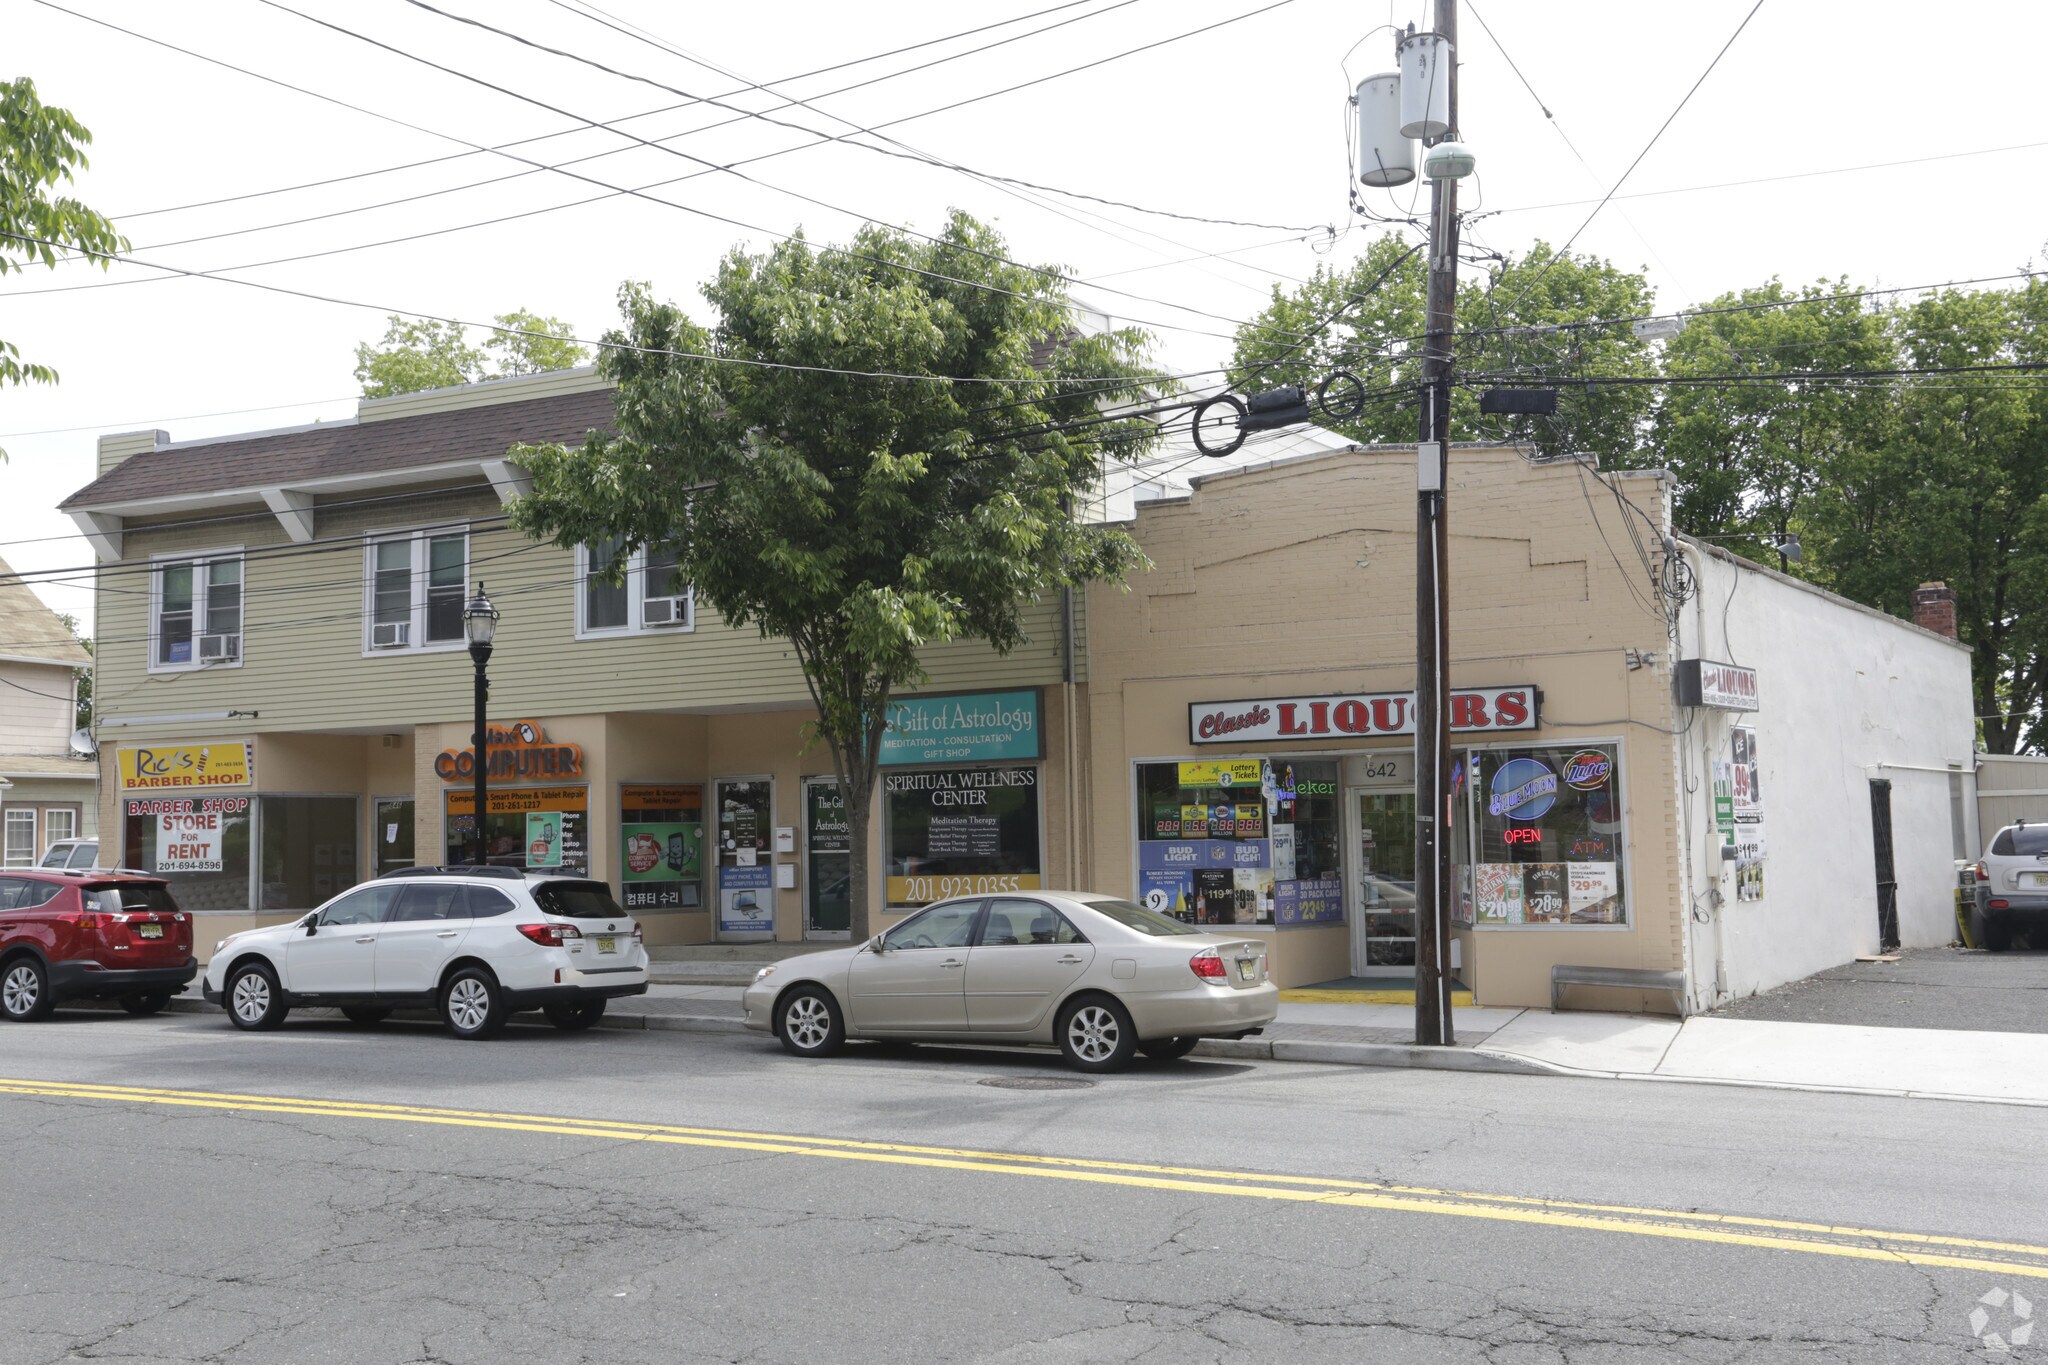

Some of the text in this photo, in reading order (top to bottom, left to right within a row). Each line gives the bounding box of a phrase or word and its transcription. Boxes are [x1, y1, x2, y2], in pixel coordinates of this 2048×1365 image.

[1716, 667, 1756, 698] LIQUORS
[896, 705, 929, 731] Gift
[932, 704, 948, 730] of
[951, 701, 1033, 732] Astrology
[1199, 691, 1529, 739] Classic LIQURS
[884, 738, 936, 749] MEDITATION
[943, 734, 1012, 745] CONSULTATION
[923, 749, 971, 759] GIFT SHOP
[434, 747, 578, 779] COMPUTER
[1565, 762, 1609, 783] Lite
[126, 774, 244, 788] BARBER SHOP
[886, 770, 1035, 791] SPIRITUAL WELLNESS
[450, 794, 476, 803] Comput
[490, 793, 510, 801] Smart
[511, 791, 531, 800] Phone
[533, 791, 539, 799] &
[541, 791, 561, 799] Tablet
[562, 789, 585, 798] Repair
[818, 796, 844, 808] The Gif
[931, 790, 987, 806] CENTER
[1489, 777, 1556, 816] BLUE MOON
[128, 798, 248, 816] BARBER SHOP
[492, 801, 541, 810] 201-261-1217
[163, 815, 218, 831] STORE
[931, 816, 997, 825] Meditation Therapy
[181, 833, 198, 841] FOR
[1504, 828, 1541, 844] OPEN
[168, 843, 211, 859] RENT
[1235, 845, 1259, 853] BUD
[1573, 842, 1604, 854] ATM
[1164, 853, 1198, 861] LIGHT
[159, 861, 221, 870] 201-694-8596
[1532, 870, 1560, 880] FIREBALL
[905, 875, 1020, 901] 201.9230355
[1300, 881, 1313, 890] BUD
[1320, 881, 1333, 889] BUD
[1333, 880, 1340, 888] LT
[1478, 872, 1511, 897] SMIRNOF
[1570, 880, 1602, 891] $29.99
[627, 891, 679, 905] 컴퓨터 수리
[1300, 889, 1341, 899] 30 PACK CANS
